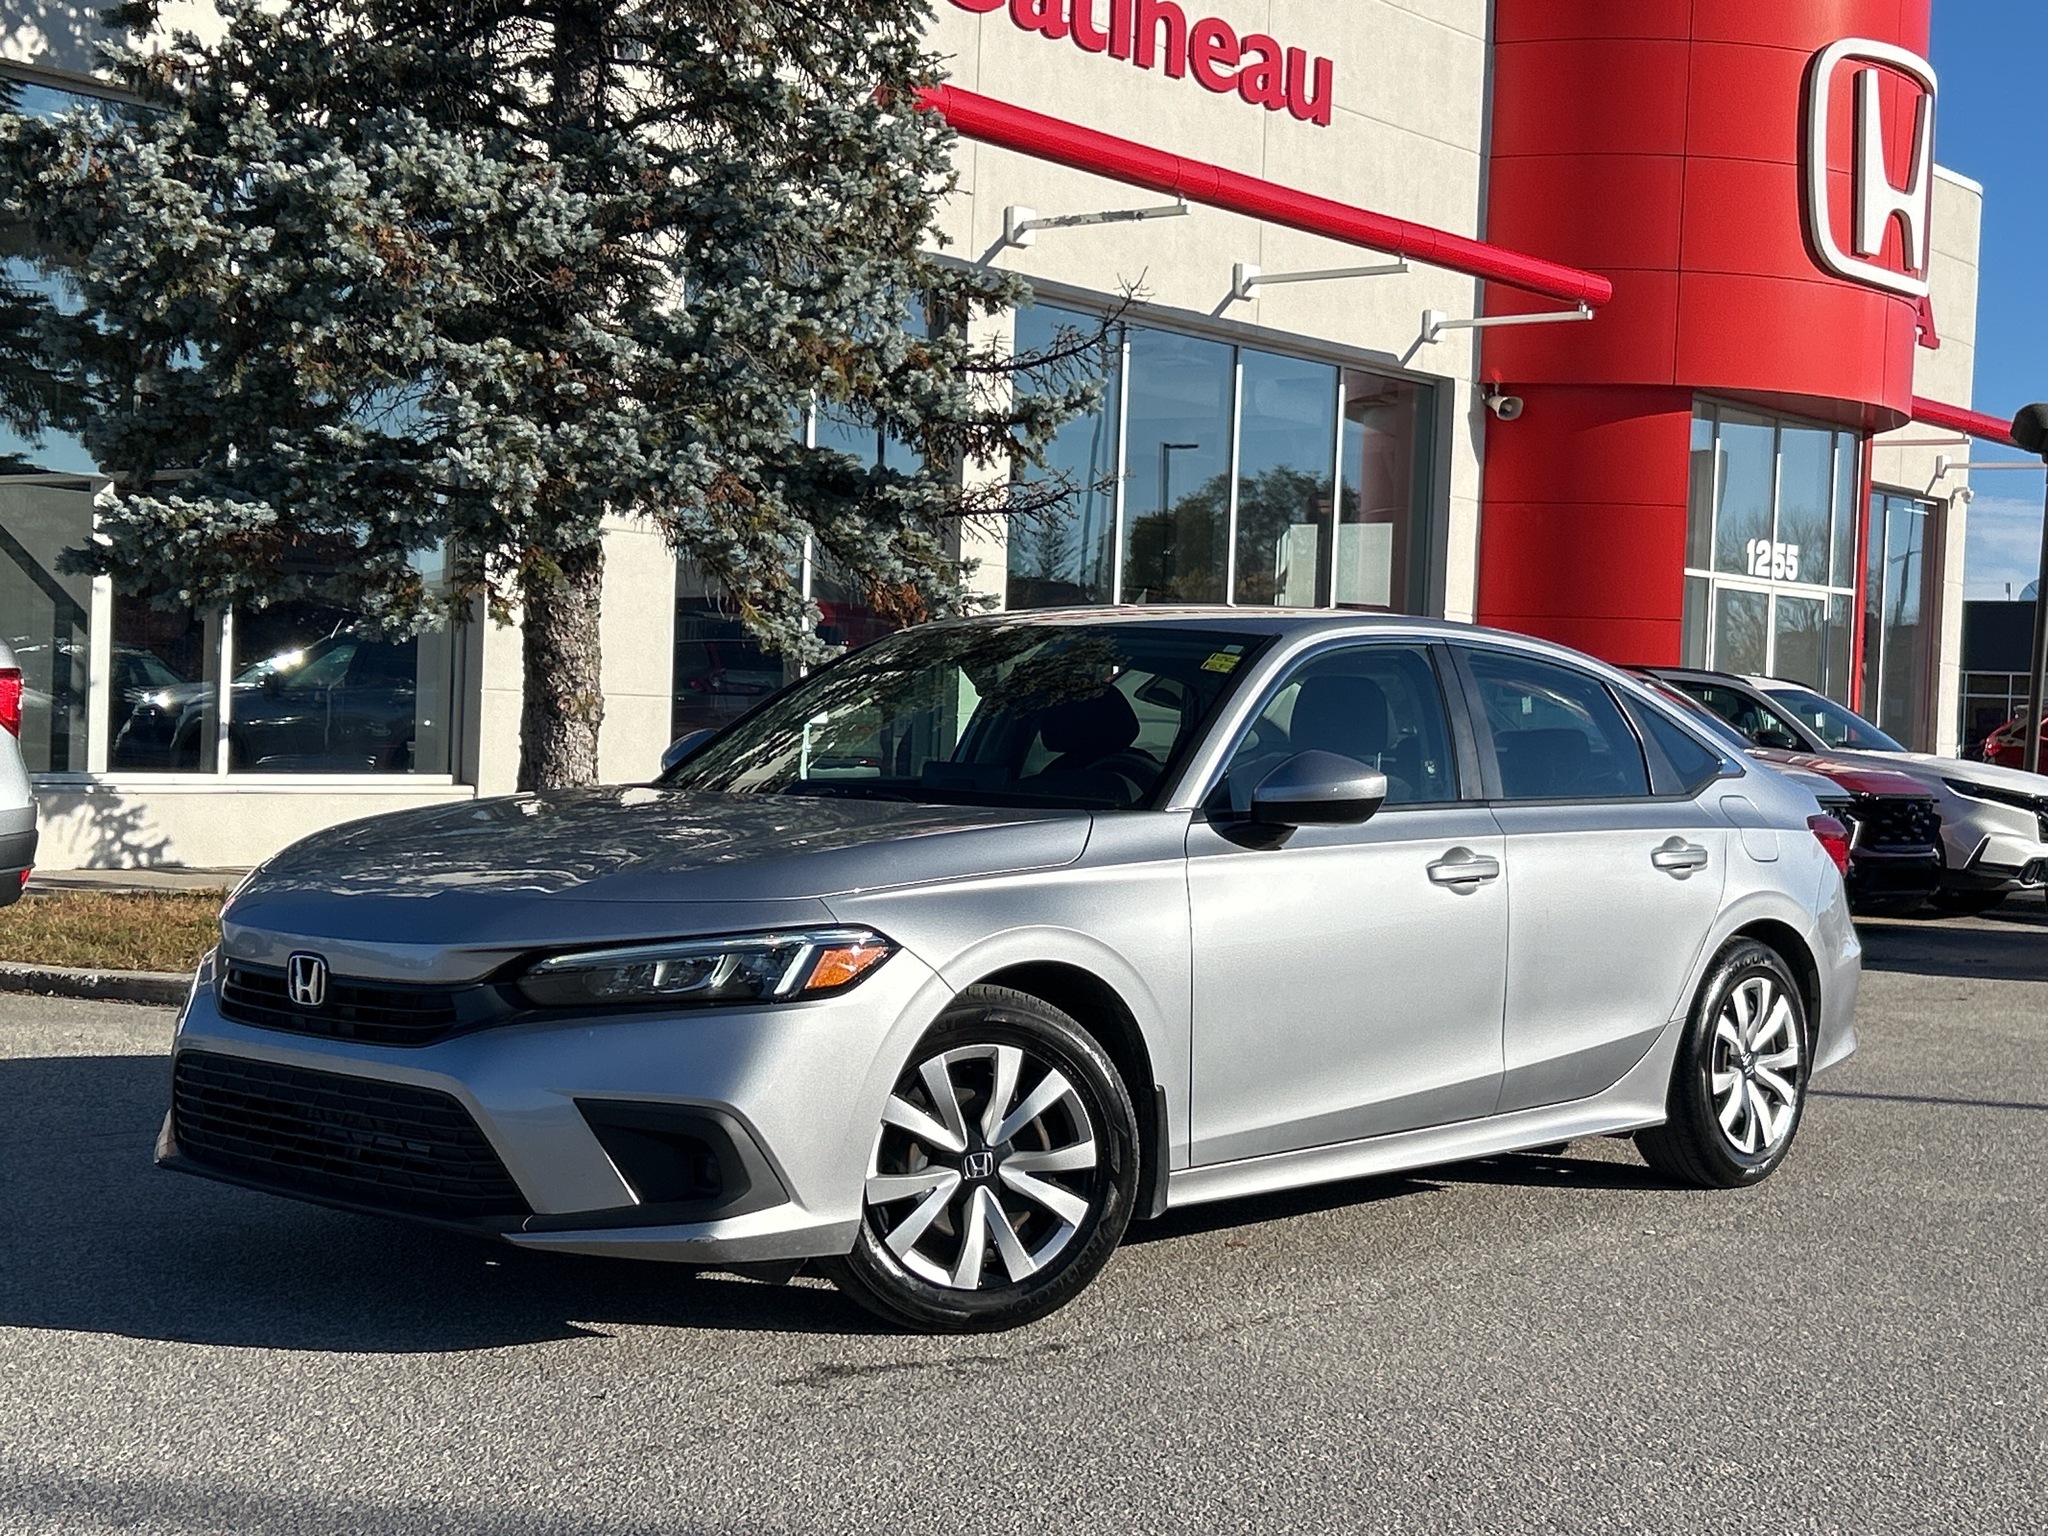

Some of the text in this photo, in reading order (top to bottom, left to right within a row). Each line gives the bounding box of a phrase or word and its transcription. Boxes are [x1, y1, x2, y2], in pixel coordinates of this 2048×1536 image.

[948, 0, 1333, 127] ineau
[1853, 67, 1934, 273] H
[1746, 538, 1799, 581] 1255
